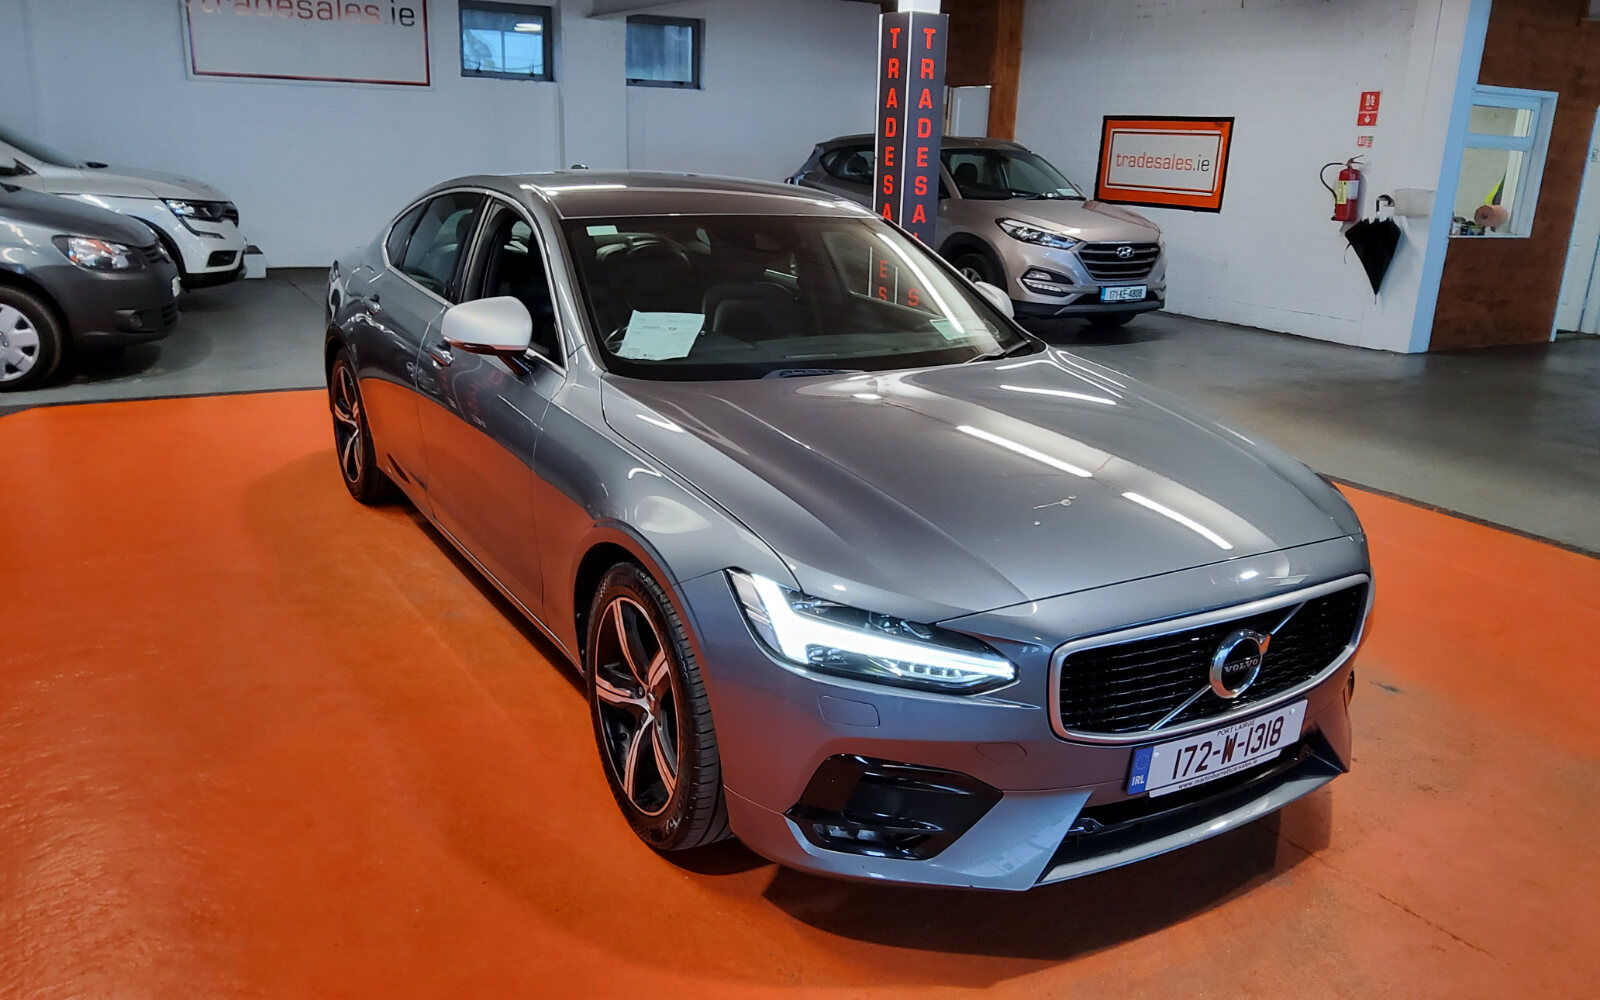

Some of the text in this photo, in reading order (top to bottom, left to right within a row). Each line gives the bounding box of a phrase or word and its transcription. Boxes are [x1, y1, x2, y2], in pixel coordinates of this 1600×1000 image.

[1116, 152, 1210, 172] tradesales.ie
[1224, 658, 1259, 673] VOLVO
[1217, 726, 1234, 736] PORT
[1172, 716, 1284, 780] 172-W-1318
[1131, 775, 1145, 787] IRL
